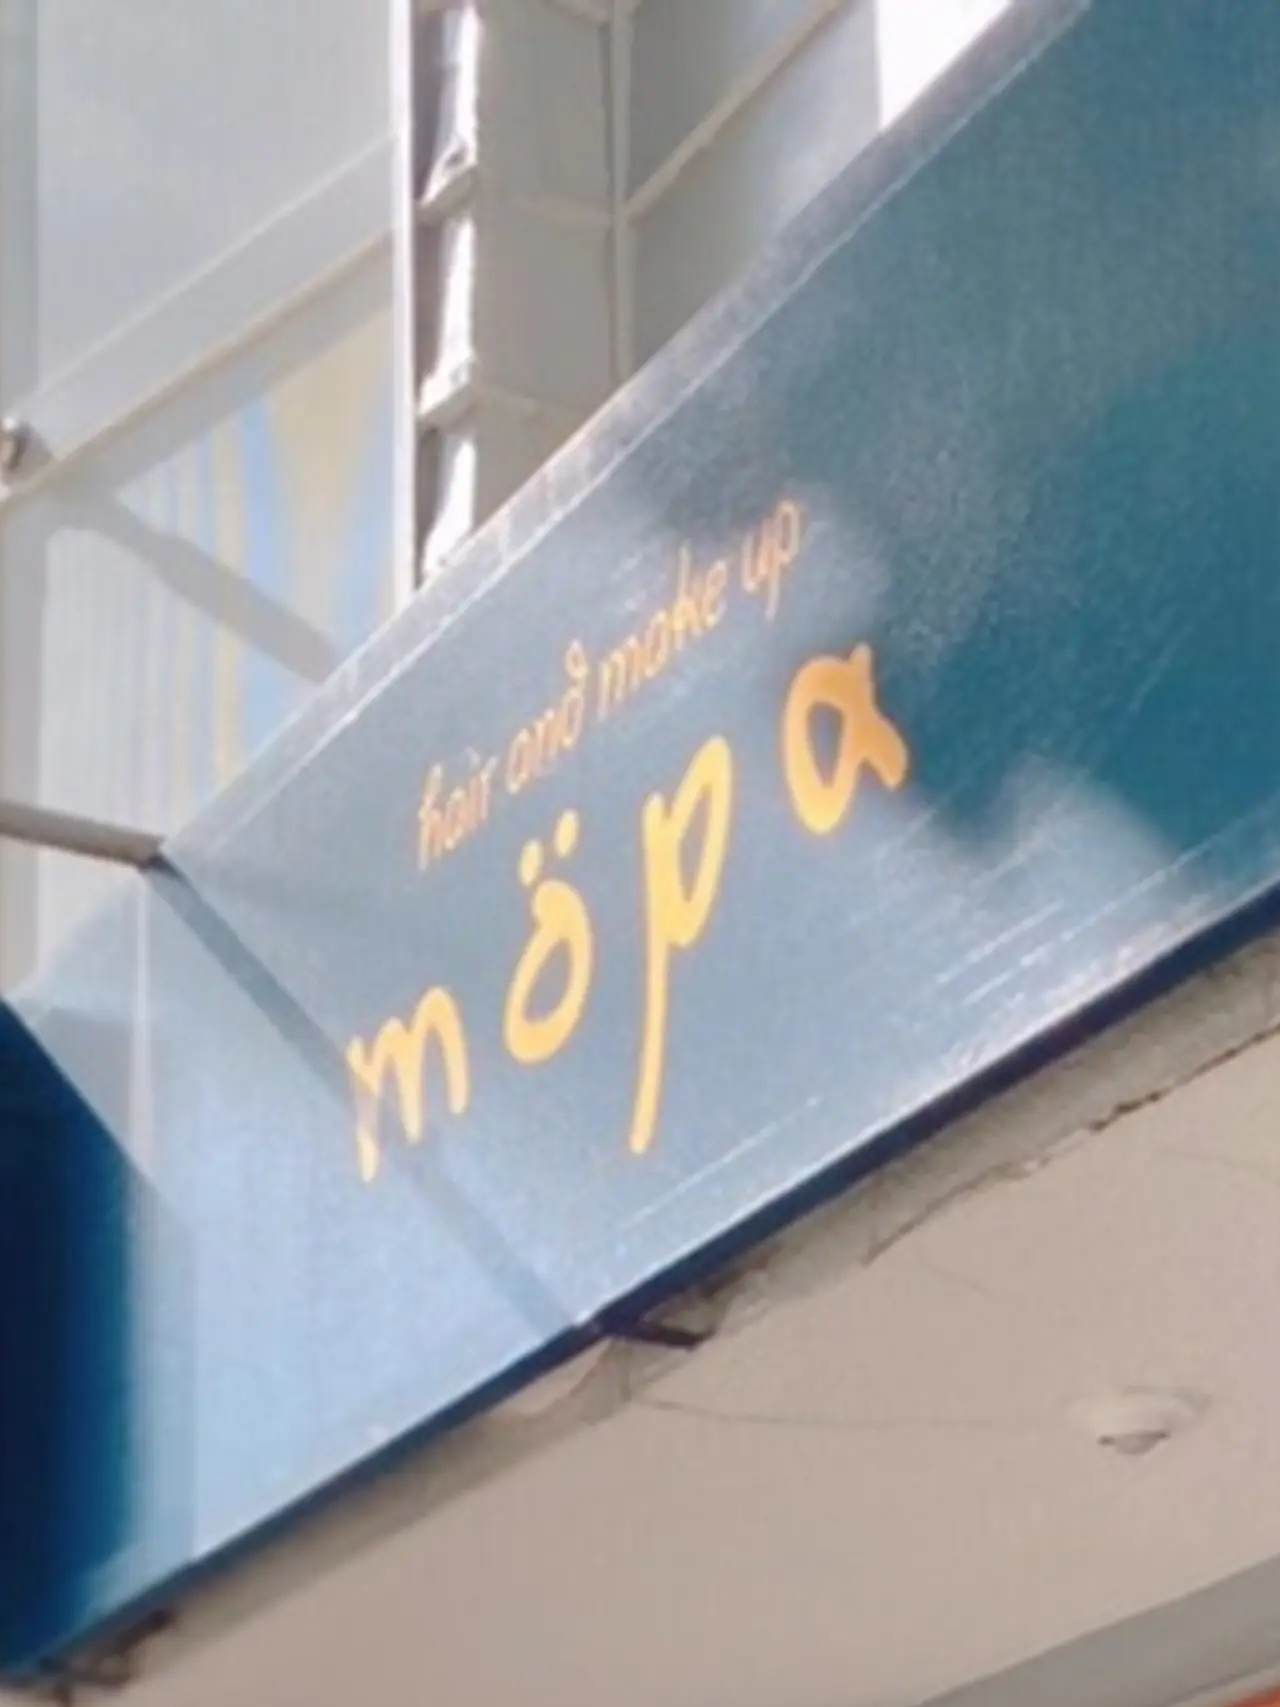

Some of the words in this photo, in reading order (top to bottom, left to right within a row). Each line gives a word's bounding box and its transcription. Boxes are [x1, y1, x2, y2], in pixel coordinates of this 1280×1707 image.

[417, 749, 497, 870] hair
[507, 641, 589, 793] and
[599, 543, 728, 719] make
[742, 500, 803, 619] up
[348, 644, 909, 1182] möpa
